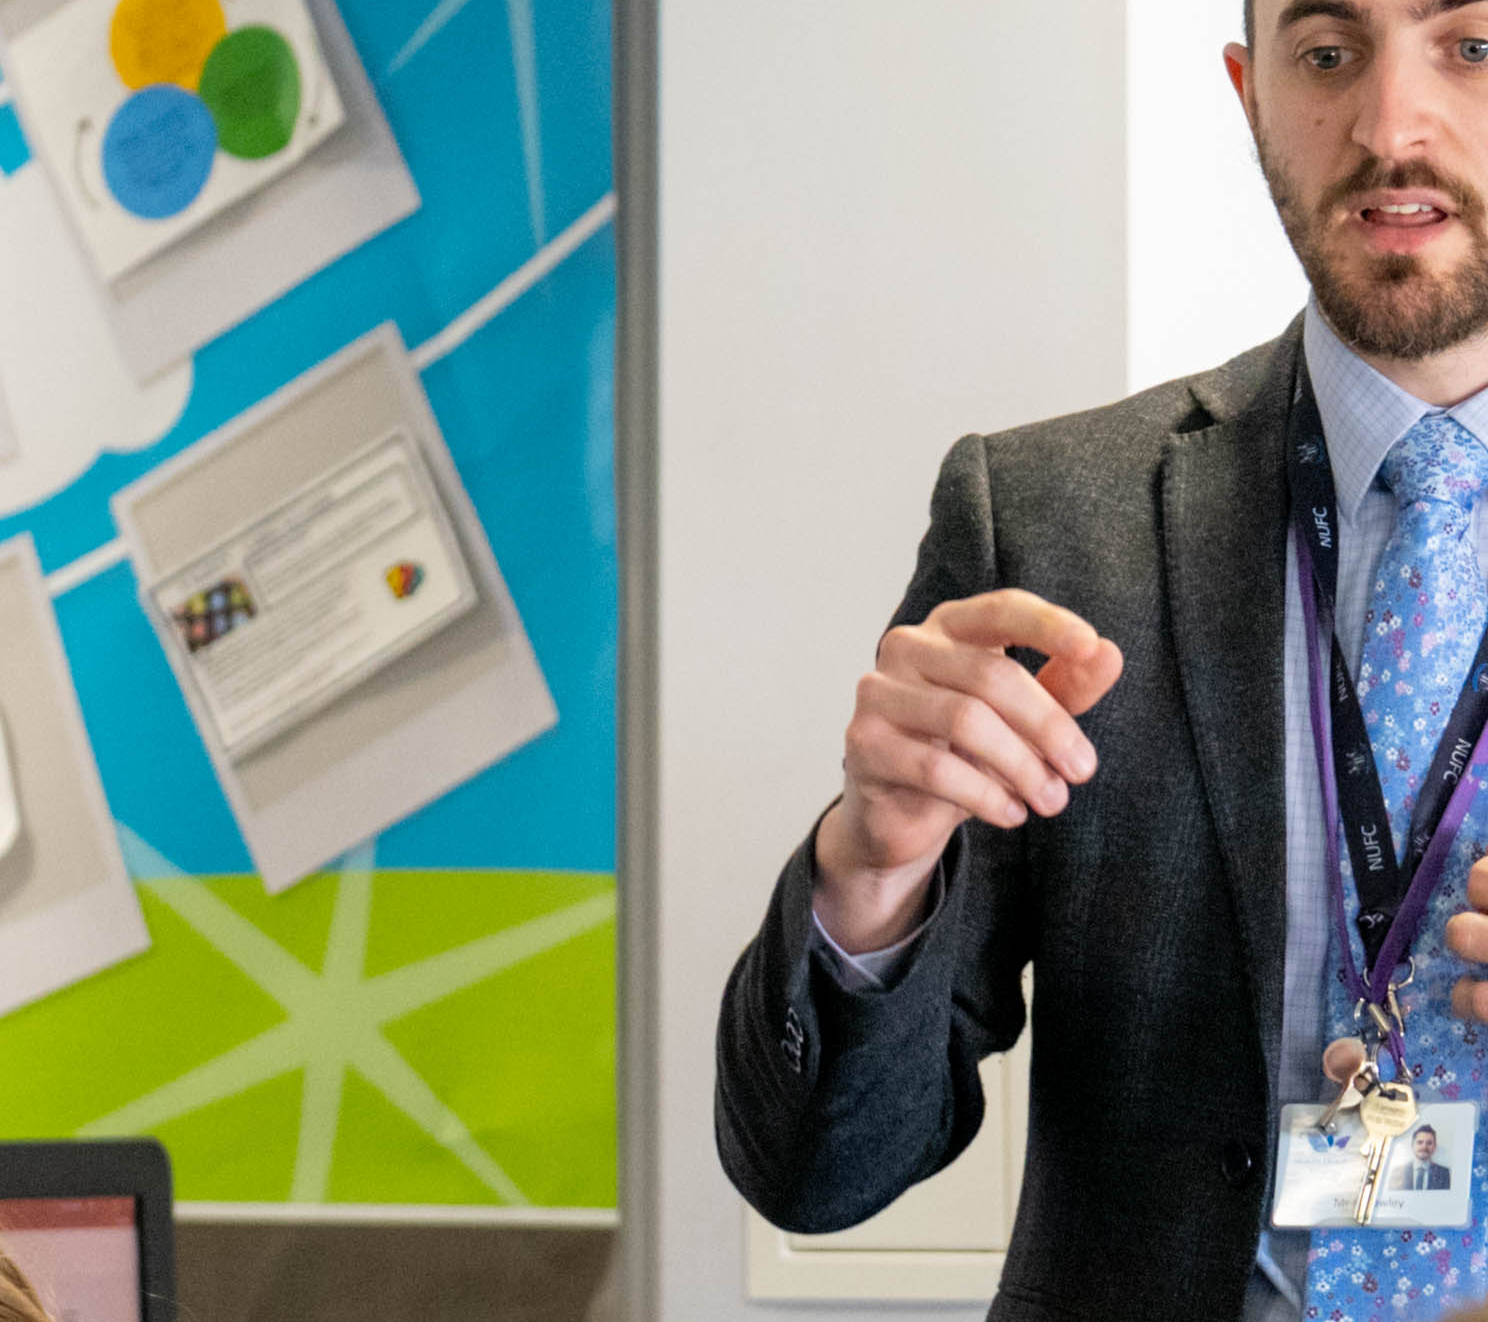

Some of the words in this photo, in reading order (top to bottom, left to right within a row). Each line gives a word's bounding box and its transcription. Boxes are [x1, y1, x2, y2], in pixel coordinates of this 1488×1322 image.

[1311, 505, 1333, 549] NUFC
[1442, 737, 1473, 783] NUFC
[1360, 823, 1385, 872] NUFC
